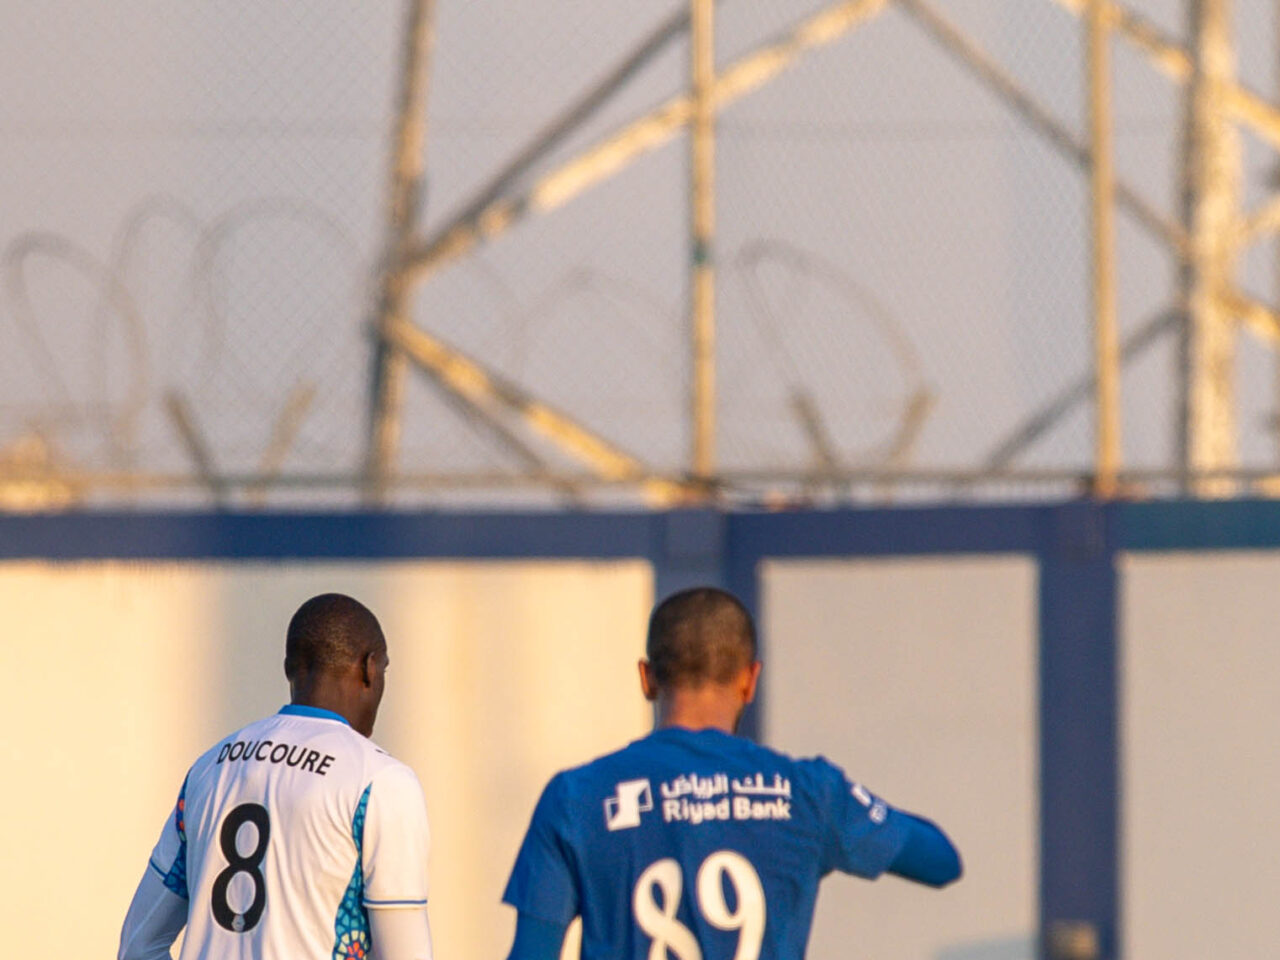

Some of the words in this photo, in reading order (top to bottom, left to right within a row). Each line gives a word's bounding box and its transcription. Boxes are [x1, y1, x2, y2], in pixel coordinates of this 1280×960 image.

[217, 740, 335, 775] DOUCOURE
[661, 773, 729, 798] الرياض
[663, 797, 730, 825] Riyad
[733, 796, 791, 820] Bank
[211, 802, 271, 933] 8
